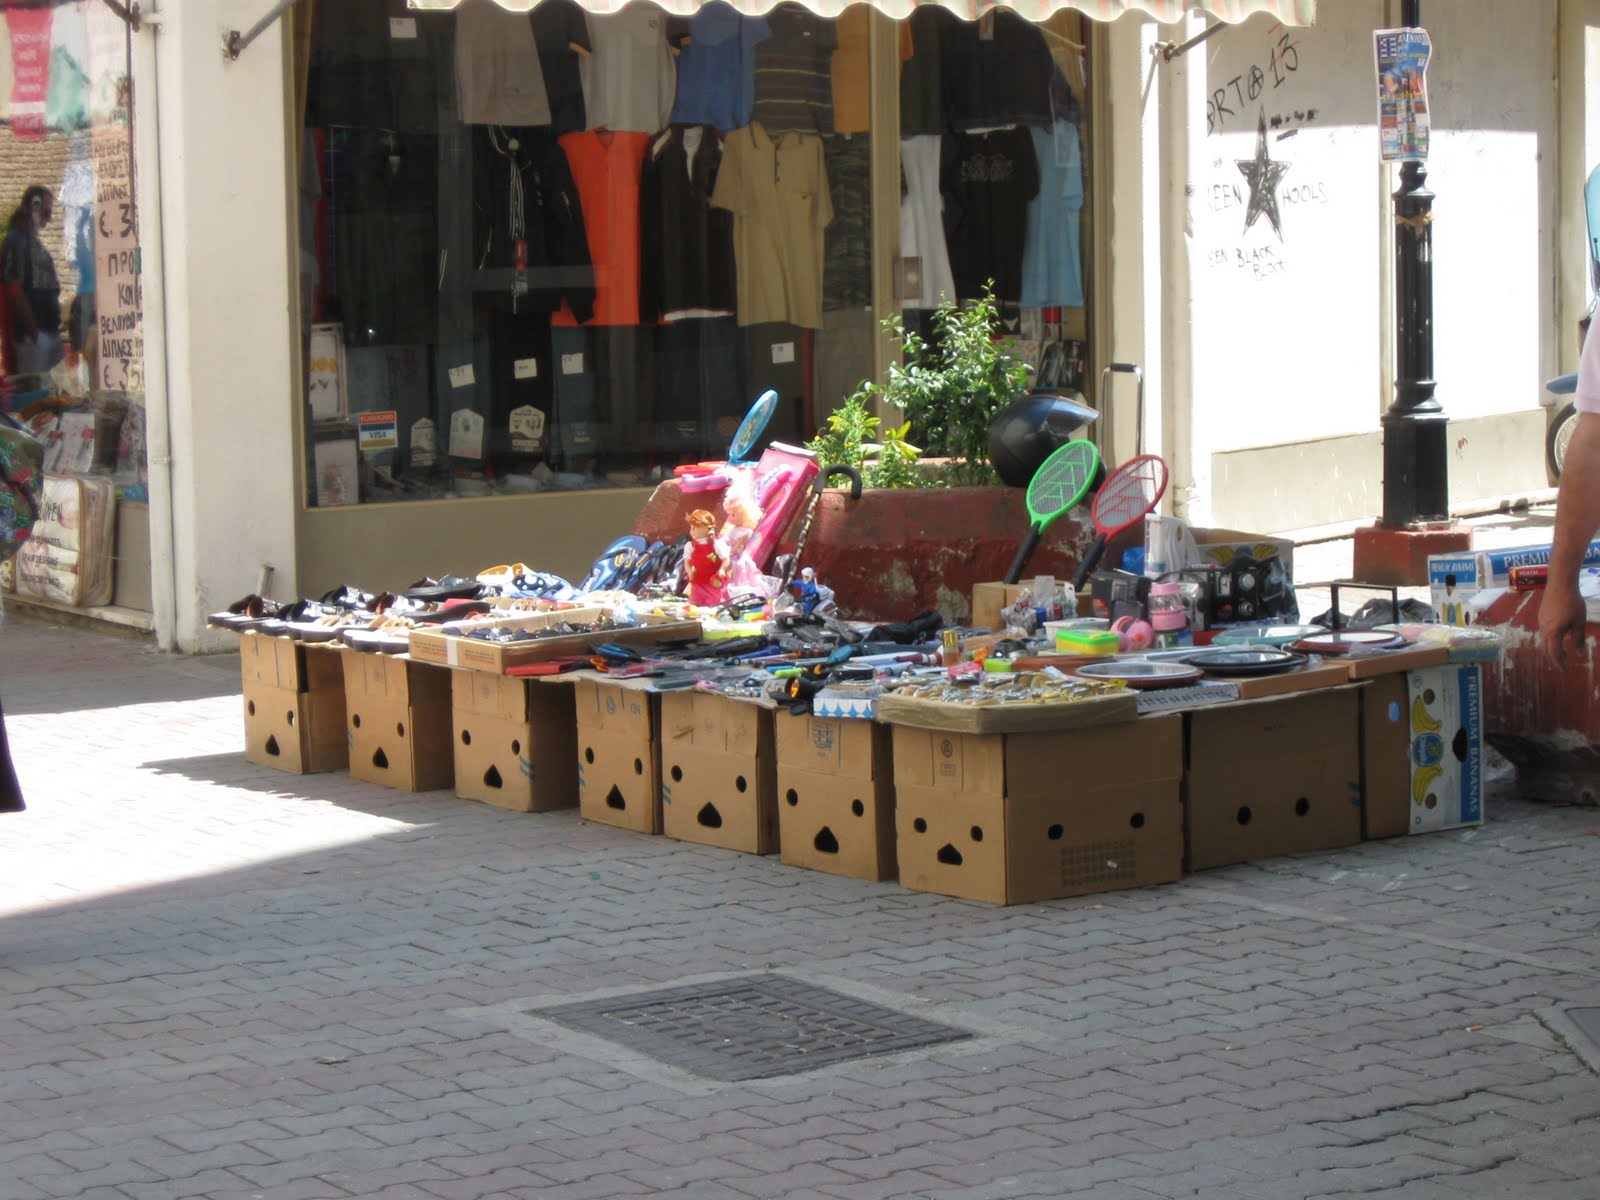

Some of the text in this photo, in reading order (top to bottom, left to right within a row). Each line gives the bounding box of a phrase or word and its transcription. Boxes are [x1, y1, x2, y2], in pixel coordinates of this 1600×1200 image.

[369, 430, 387, 440] VISA
[1503, 551, 1552, 569] PREMI
[1466, 675, 1480, 813] PREMIUM BANANAS
